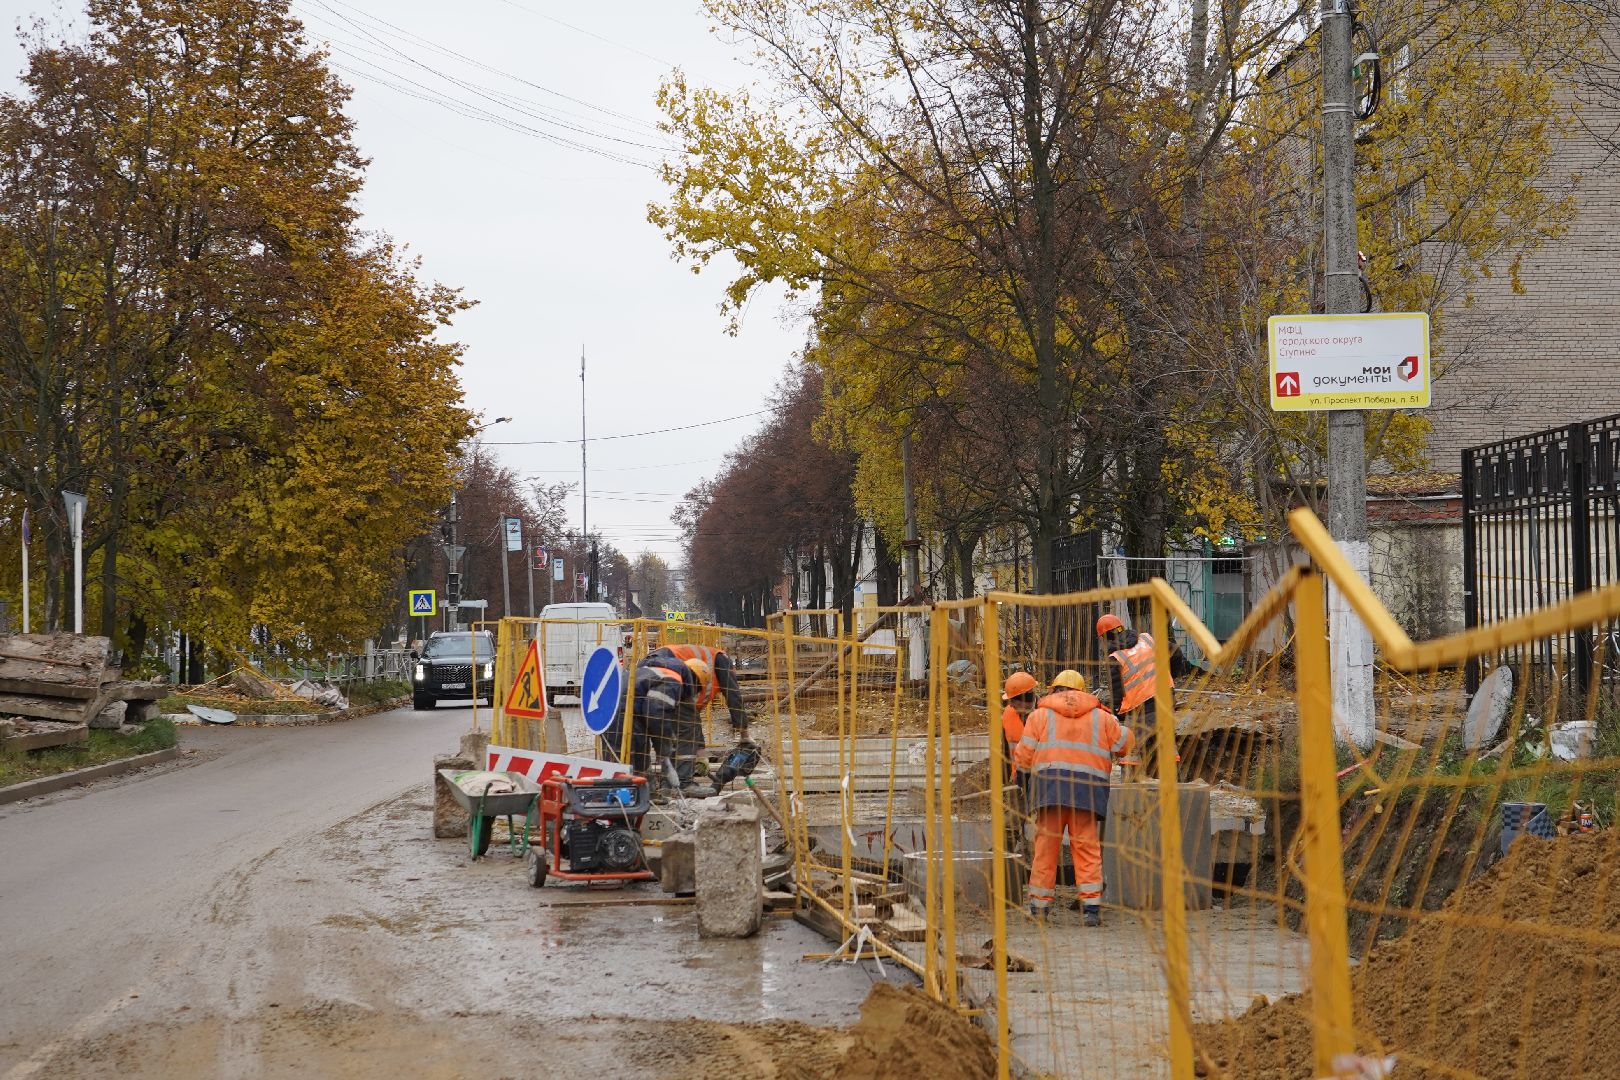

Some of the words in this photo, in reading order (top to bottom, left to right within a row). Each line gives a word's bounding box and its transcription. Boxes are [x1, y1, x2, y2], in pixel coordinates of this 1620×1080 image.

[1278, 326, 1303, 335] МФЦ
[1332, 336, 1363, 346] округа
[1362, 366, 1391, 375] мои
[1313, 374, 1392, 387] документы
[1324, 396, 1361, 405] Проспект
[1410, 395, 1419, 403] 51
